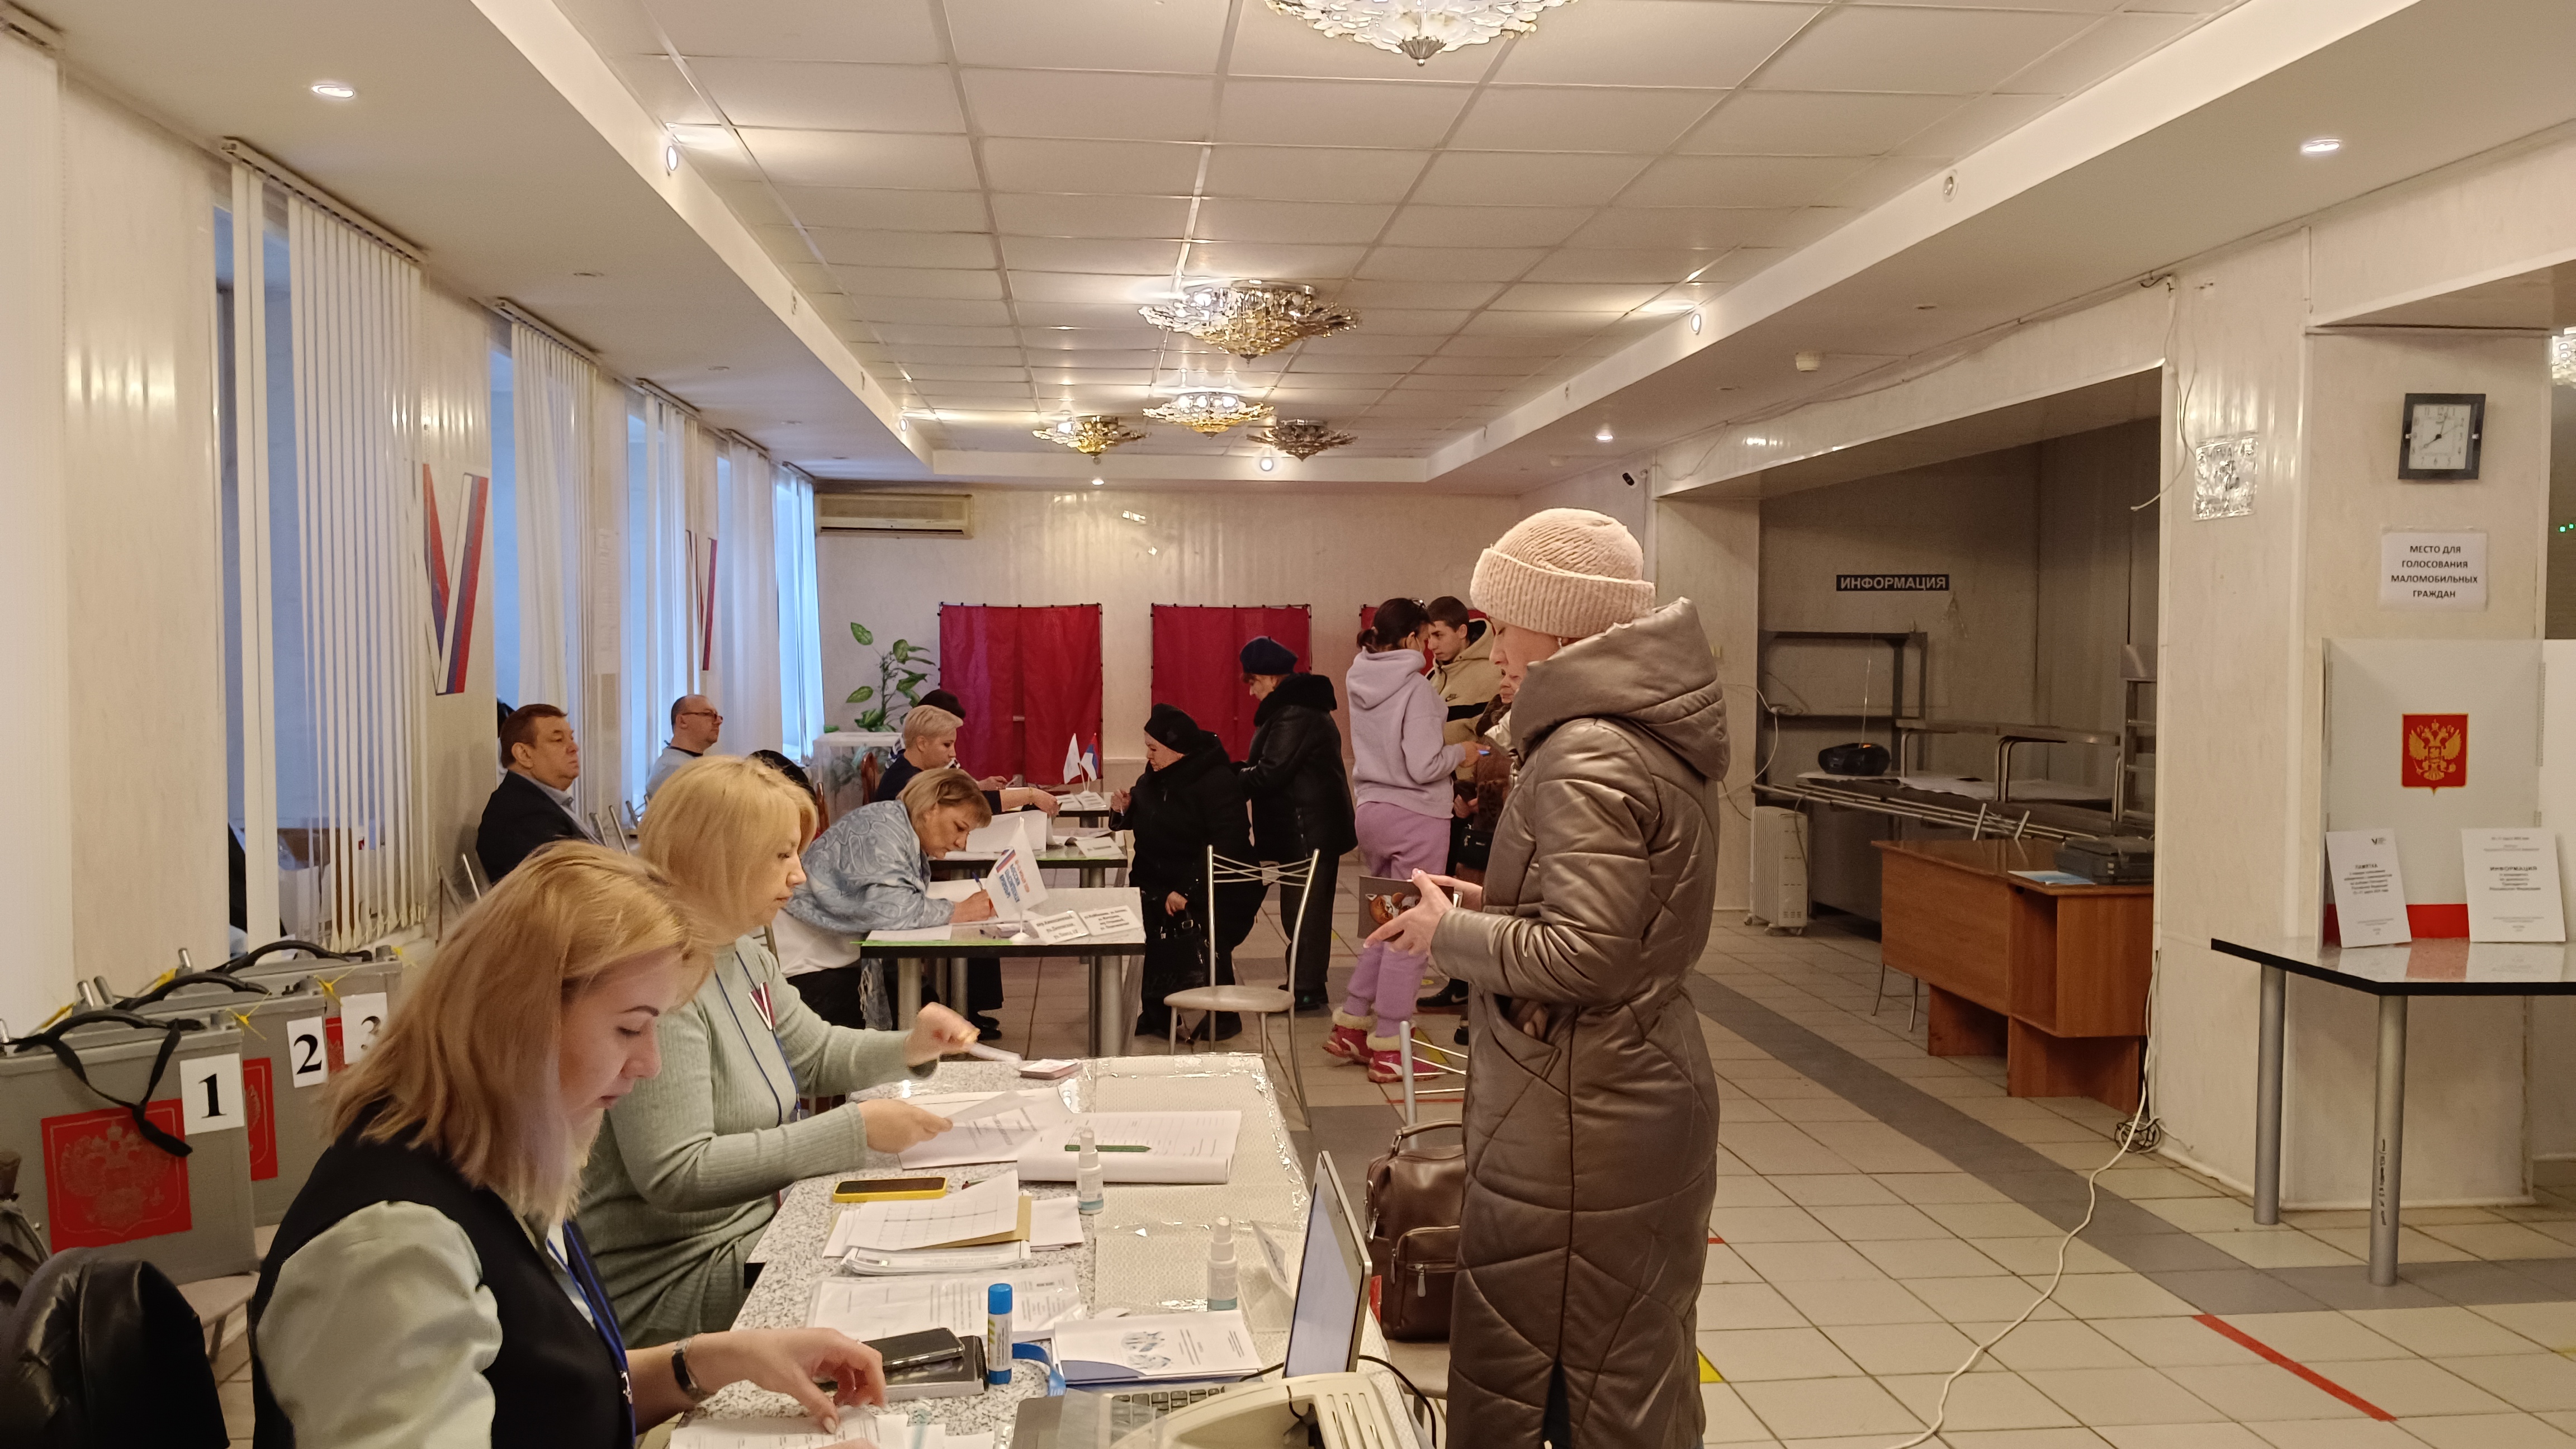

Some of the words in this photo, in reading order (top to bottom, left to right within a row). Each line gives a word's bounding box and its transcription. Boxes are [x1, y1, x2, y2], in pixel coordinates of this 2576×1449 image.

[2409, 545, 2441, 554] МЕСТО
[2442, 545, 2461, 555] ДЛЯ
[2402, 560, 2468, 569] ГОЛОСОВАНИЯ
[1840, 576, 1946, 590] ИНФОРМАЦИЯ
[2391, 575, 2478, 584] МАЛОМОБИЛЬНЫХ
[2413, 590, 2456, 599] ГРАЖДАН
[293, 1034, 323, 1076] 2
[197, 1073, 228, 1119] 1
